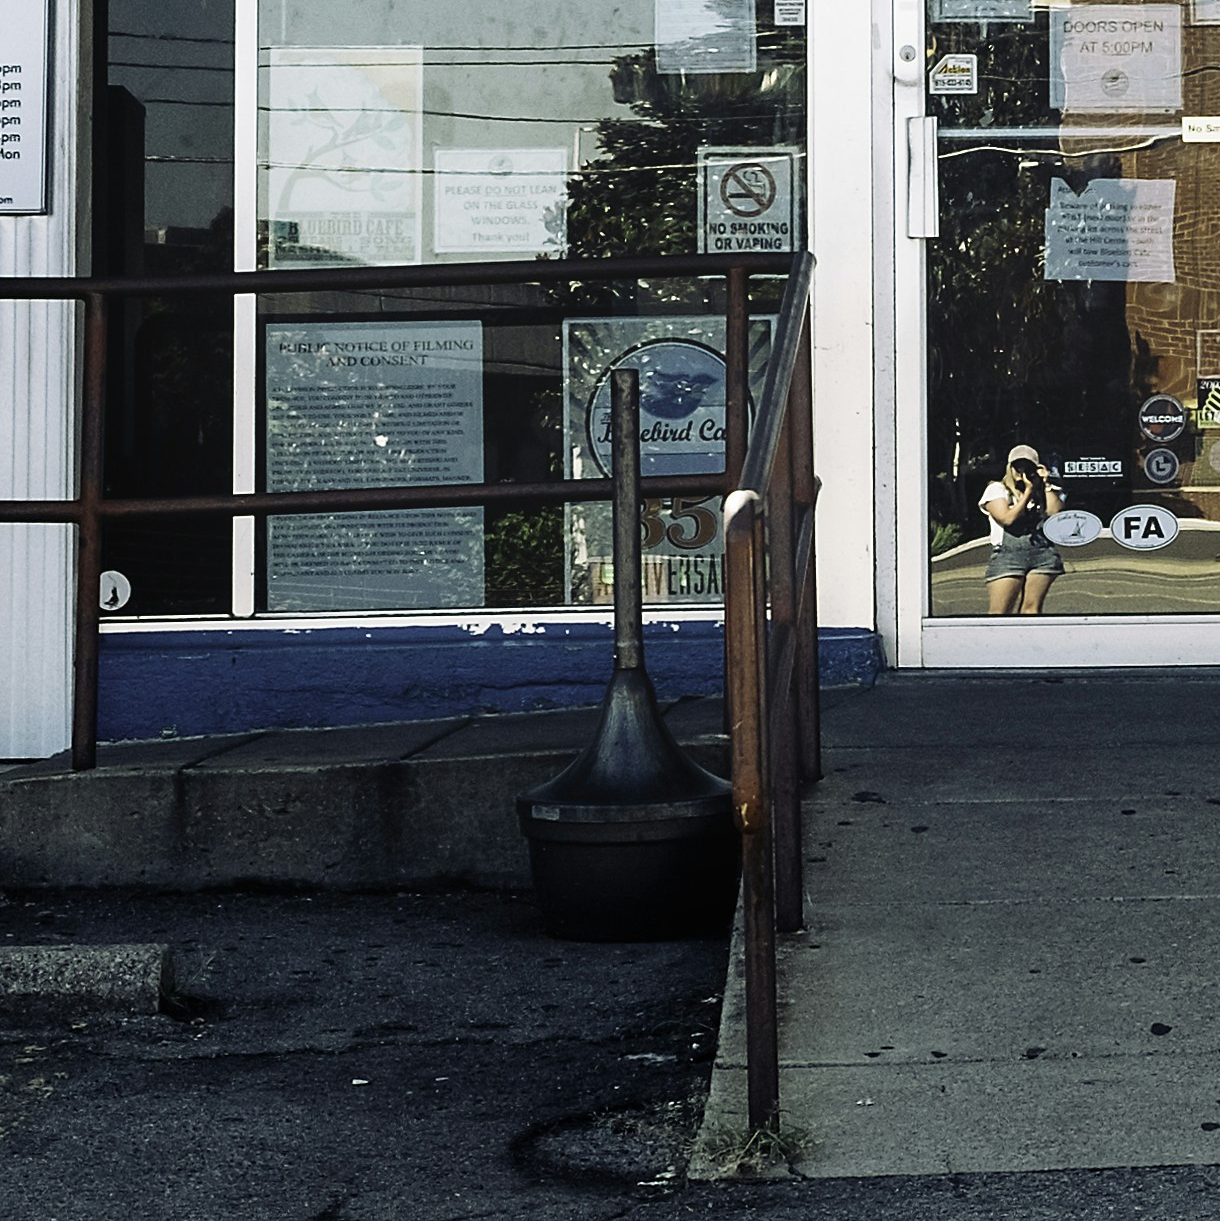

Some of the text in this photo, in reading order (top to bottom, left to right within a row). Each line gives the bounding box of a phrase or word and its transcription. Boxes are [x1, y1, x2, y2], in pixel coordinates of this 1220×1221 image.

[1063, 20, 1164, 33] DOORS OPEN
[1079, 41, 1153, 54] AT 5:00PM
[0, 65, 22, 77] pm
[0, 82, 21, 94] pm
[0, 99, 21, 111] pm
[1188, 124, 1203, 133] No
[444, 185, 557, 195] PLEASE DO NOT LEAN
[463, 200, 538, 210] ON THE GLASS
[708, 222, 789, 235] NO SMOKING
[472, 231, 503, 242] Thank
[714, 237, 783, 250] OR VAPING
[279, 339, 474, 354] PUBLIC NOTICE OF FILMING
[326, 355, 429, 368] AND CONSENT
[1141, 415, 1184, 424] WELCOME
[597, 418, 726, 443] ebird Ca
[1123, 516, 1165, 539] FA
